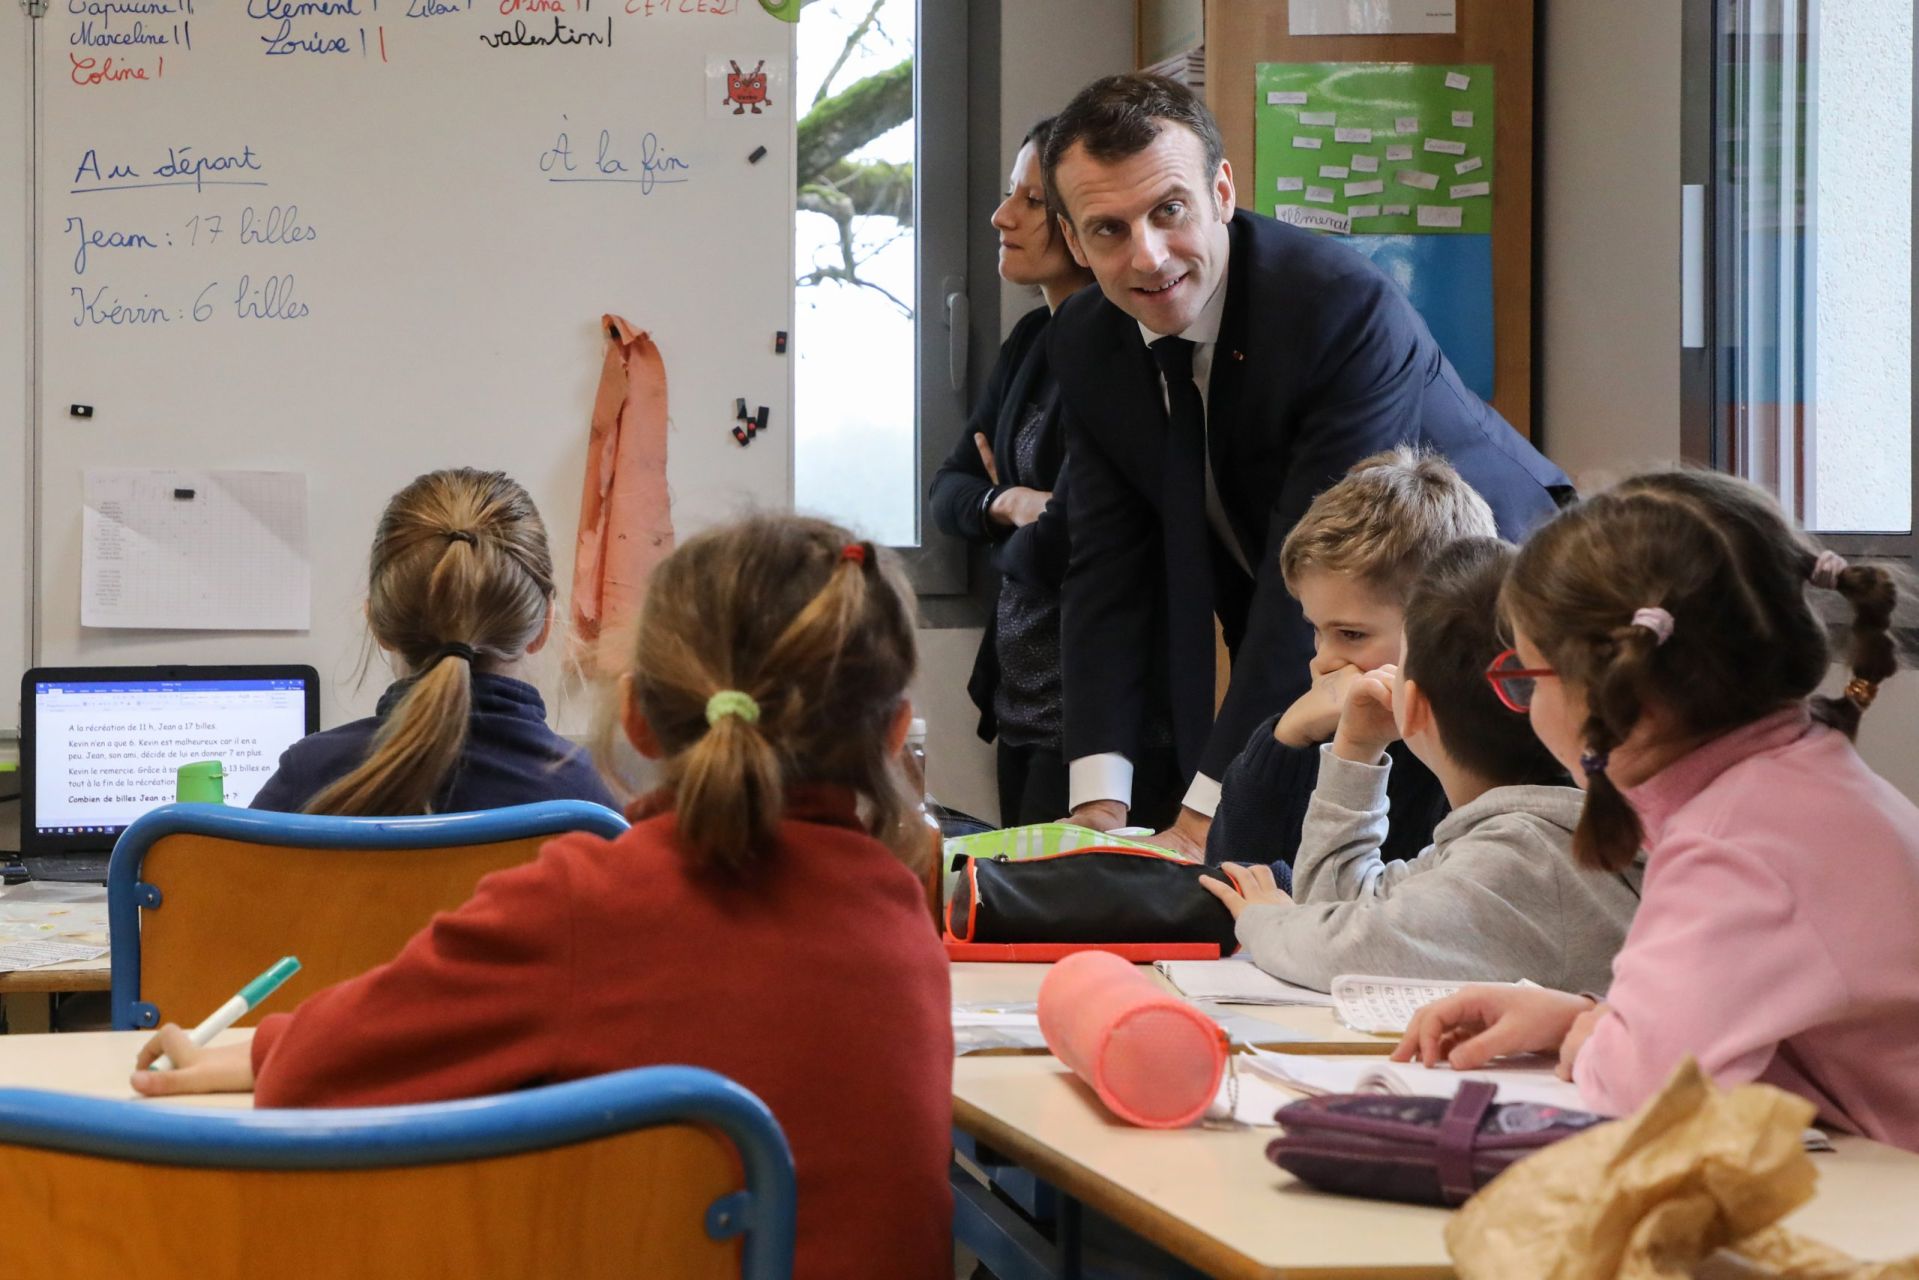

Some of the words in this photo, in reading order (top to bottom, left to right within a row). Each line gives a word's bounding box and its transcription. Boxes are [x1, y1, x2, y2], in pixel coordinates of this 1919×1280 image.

[70, 20, 169, 46] Marceline
[595, 129, 629, 174] la
[641, 132, 689, 195] fin
[75, 149, 140, 183] Au
[153, 145, 262, 193] départ
[185, 215, 223, 247] 17
[240, 205, 317, 245] billes
[193, 281, 218, 322] 6
[234, 273, 310, 320] billes
[77, 724, 84, 732] la
[85, 724, 126, 732] récréation
[158, 723, 177, 731] Jean
[175, 738, 218, 746] malheureux
[234, 737, 240, 745] il
[140, 751, 166, 759] décide
[168, 750, 177, 758] de
[180, 750, 188, 758] lui
[138, 766, 160, 774] Grâce
[240, 764, 259, 772] billes
[103, 779, 114, 787] fin
[115, 779, 125, 787] de
[69, 795, 101, 804] Combien
[104, 795, 113, 803] de
[139, 794, 159, 802] Jean
